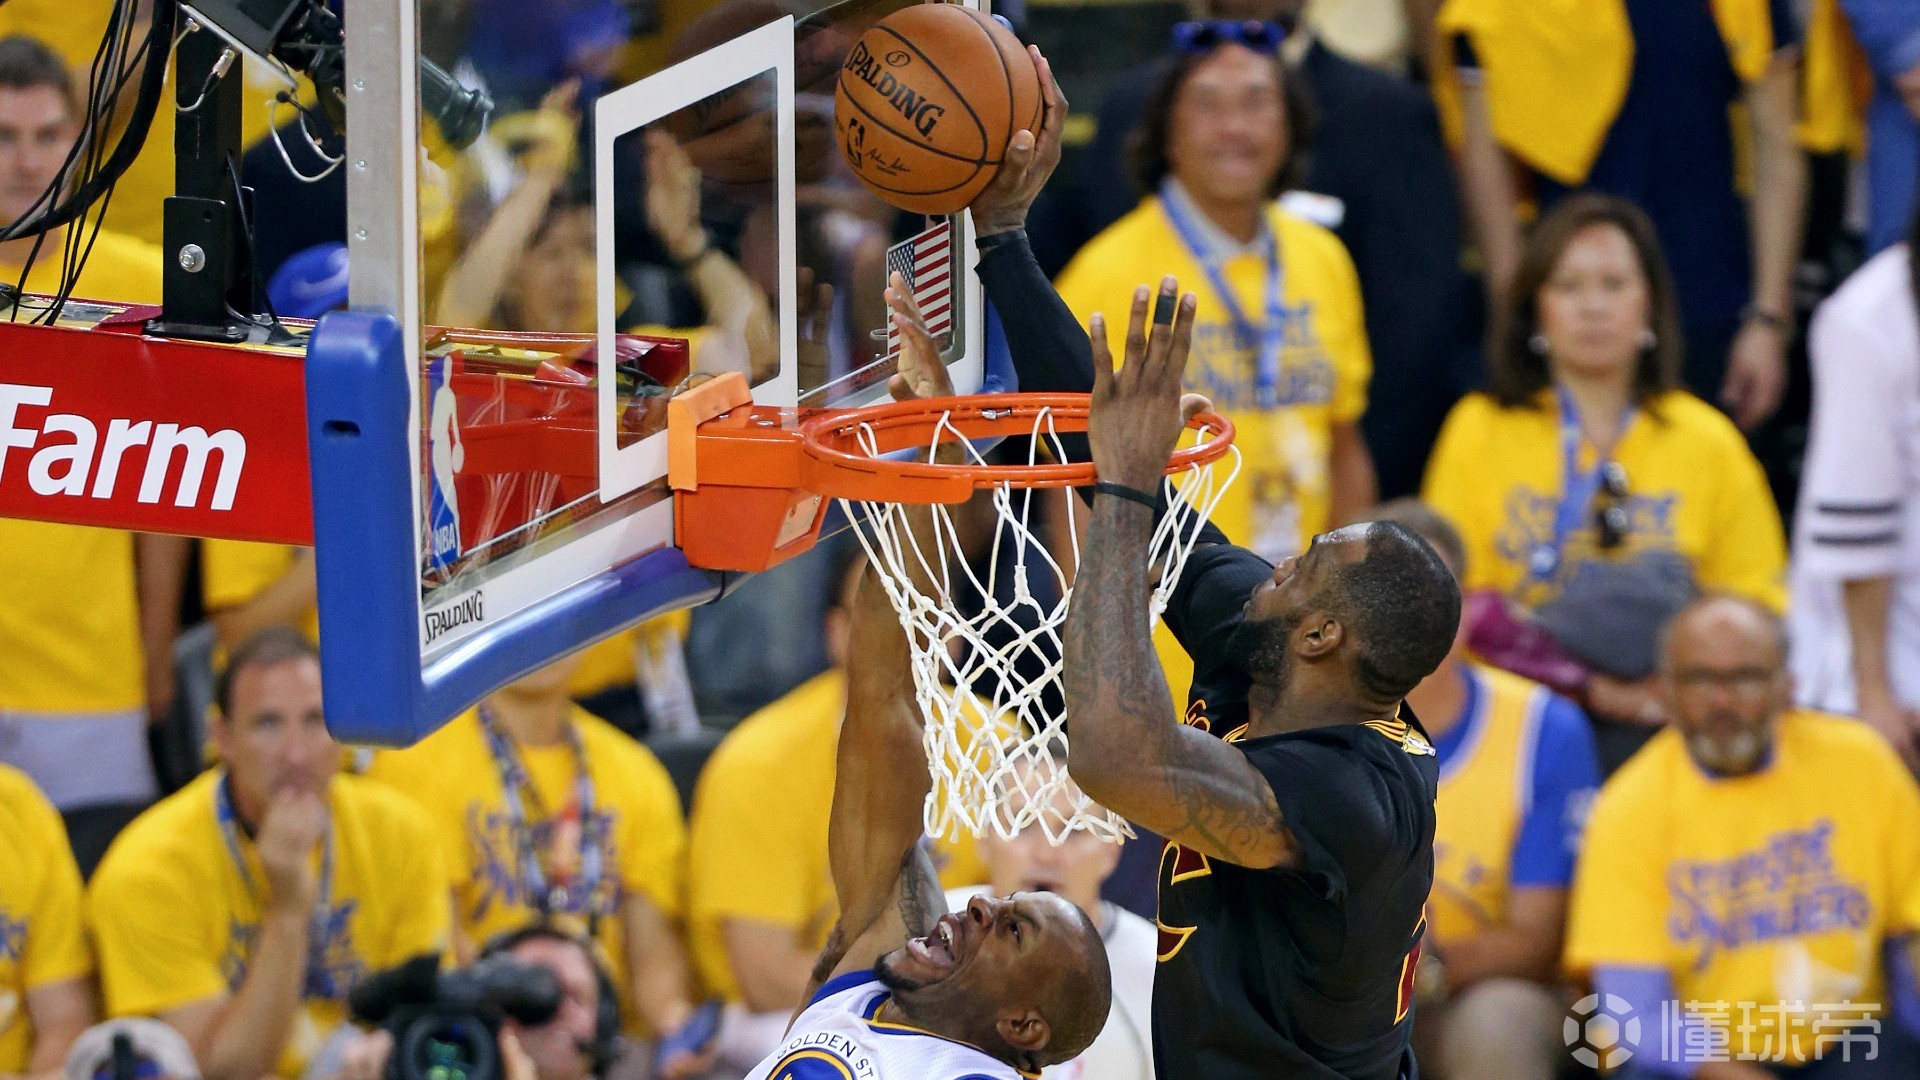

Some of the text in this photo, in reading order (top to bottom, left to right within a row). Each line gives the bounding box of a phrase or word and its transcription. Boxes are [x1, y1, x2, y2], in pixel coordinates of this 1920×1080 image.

[844, 40, 945, 137] SPALDING
[0, 383, 247, 511] Farm
[436, 522, 456, 553] NBA
[425, 590, 483, 644] SPALDING
